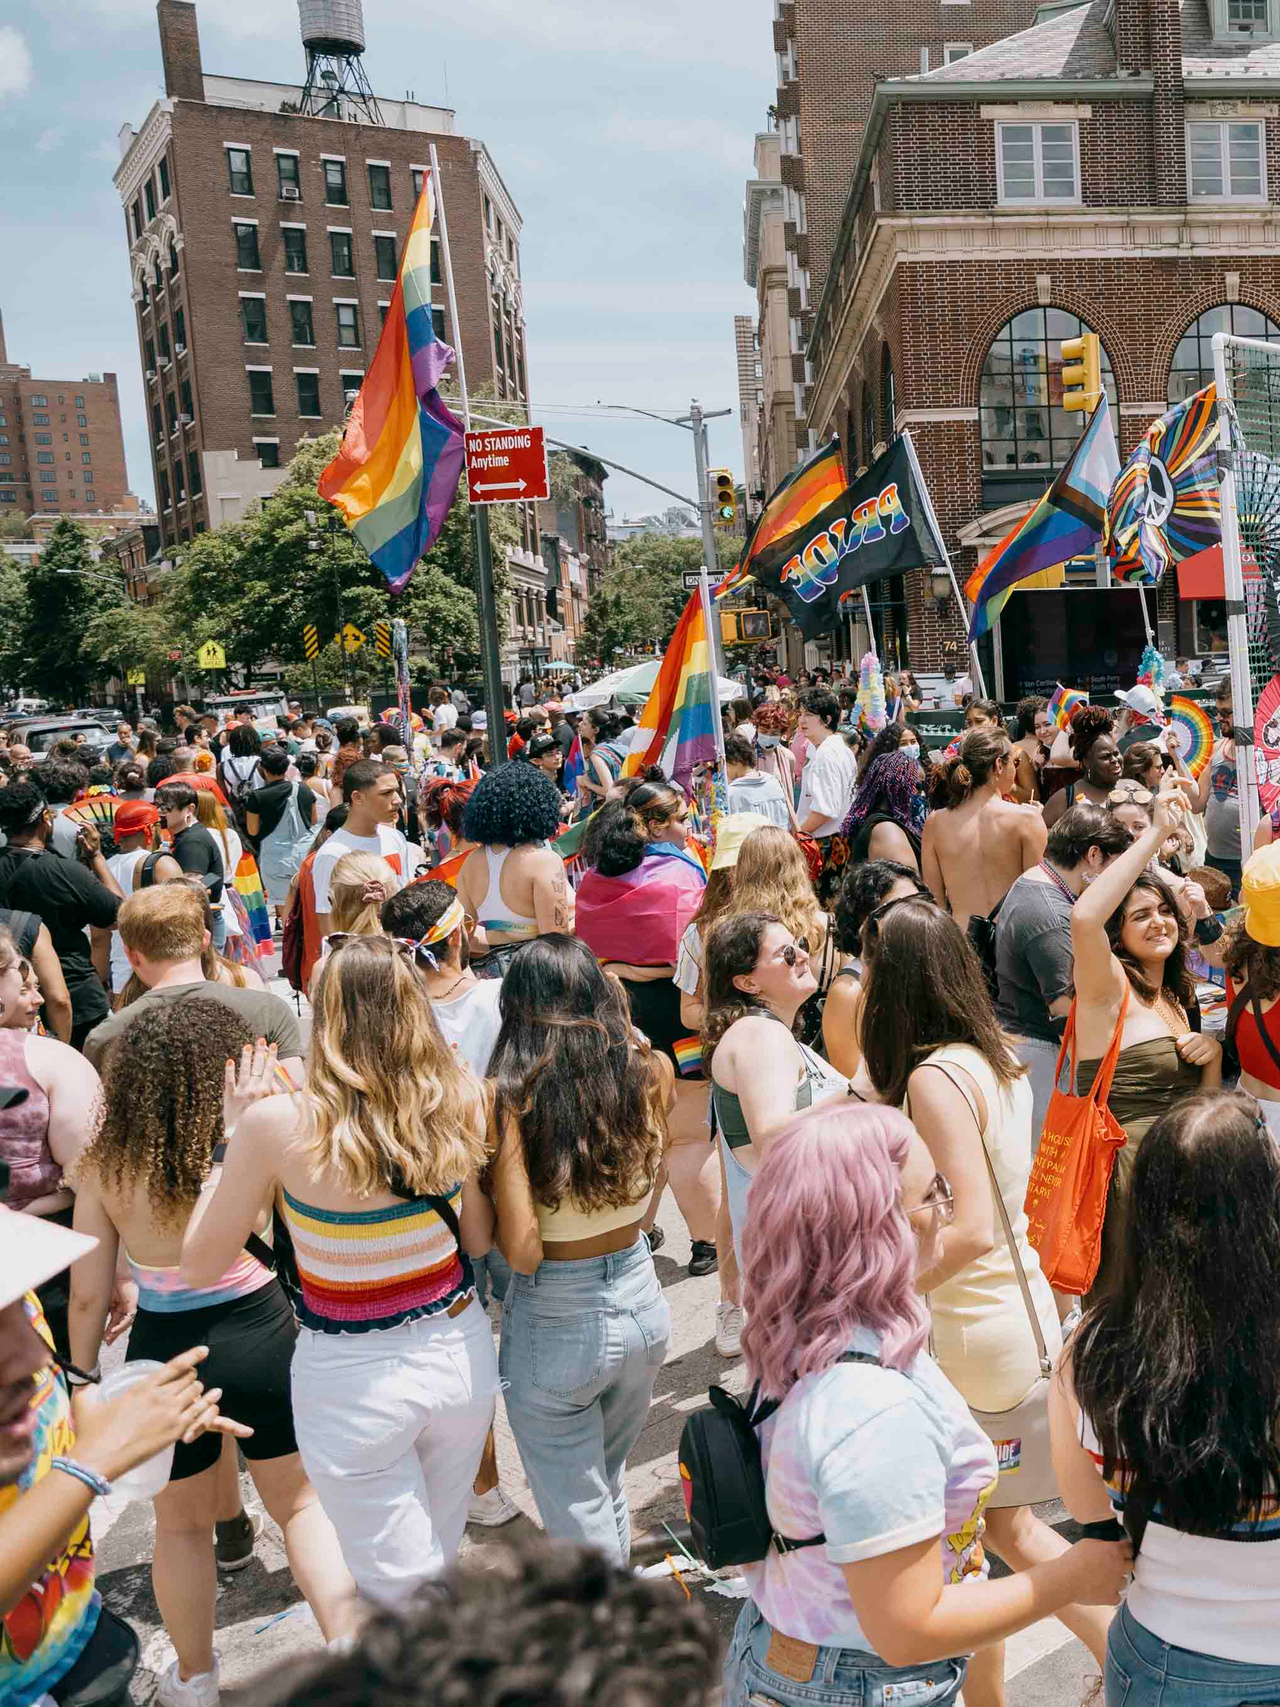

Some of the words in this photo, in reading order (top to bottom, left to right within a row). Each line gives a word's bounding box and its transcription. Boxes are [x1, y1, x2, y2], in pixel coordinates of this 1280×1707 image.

[469, 439, 482, 452] NO
[484, 435, 531, 451] STANDING
[471, 454, 509, 470] Anytime
[943, 641, 957, 652] 74
[1048, 1131, 1073, 1147] HOUSE
[995, 1443, 1016, 1462] IDE
